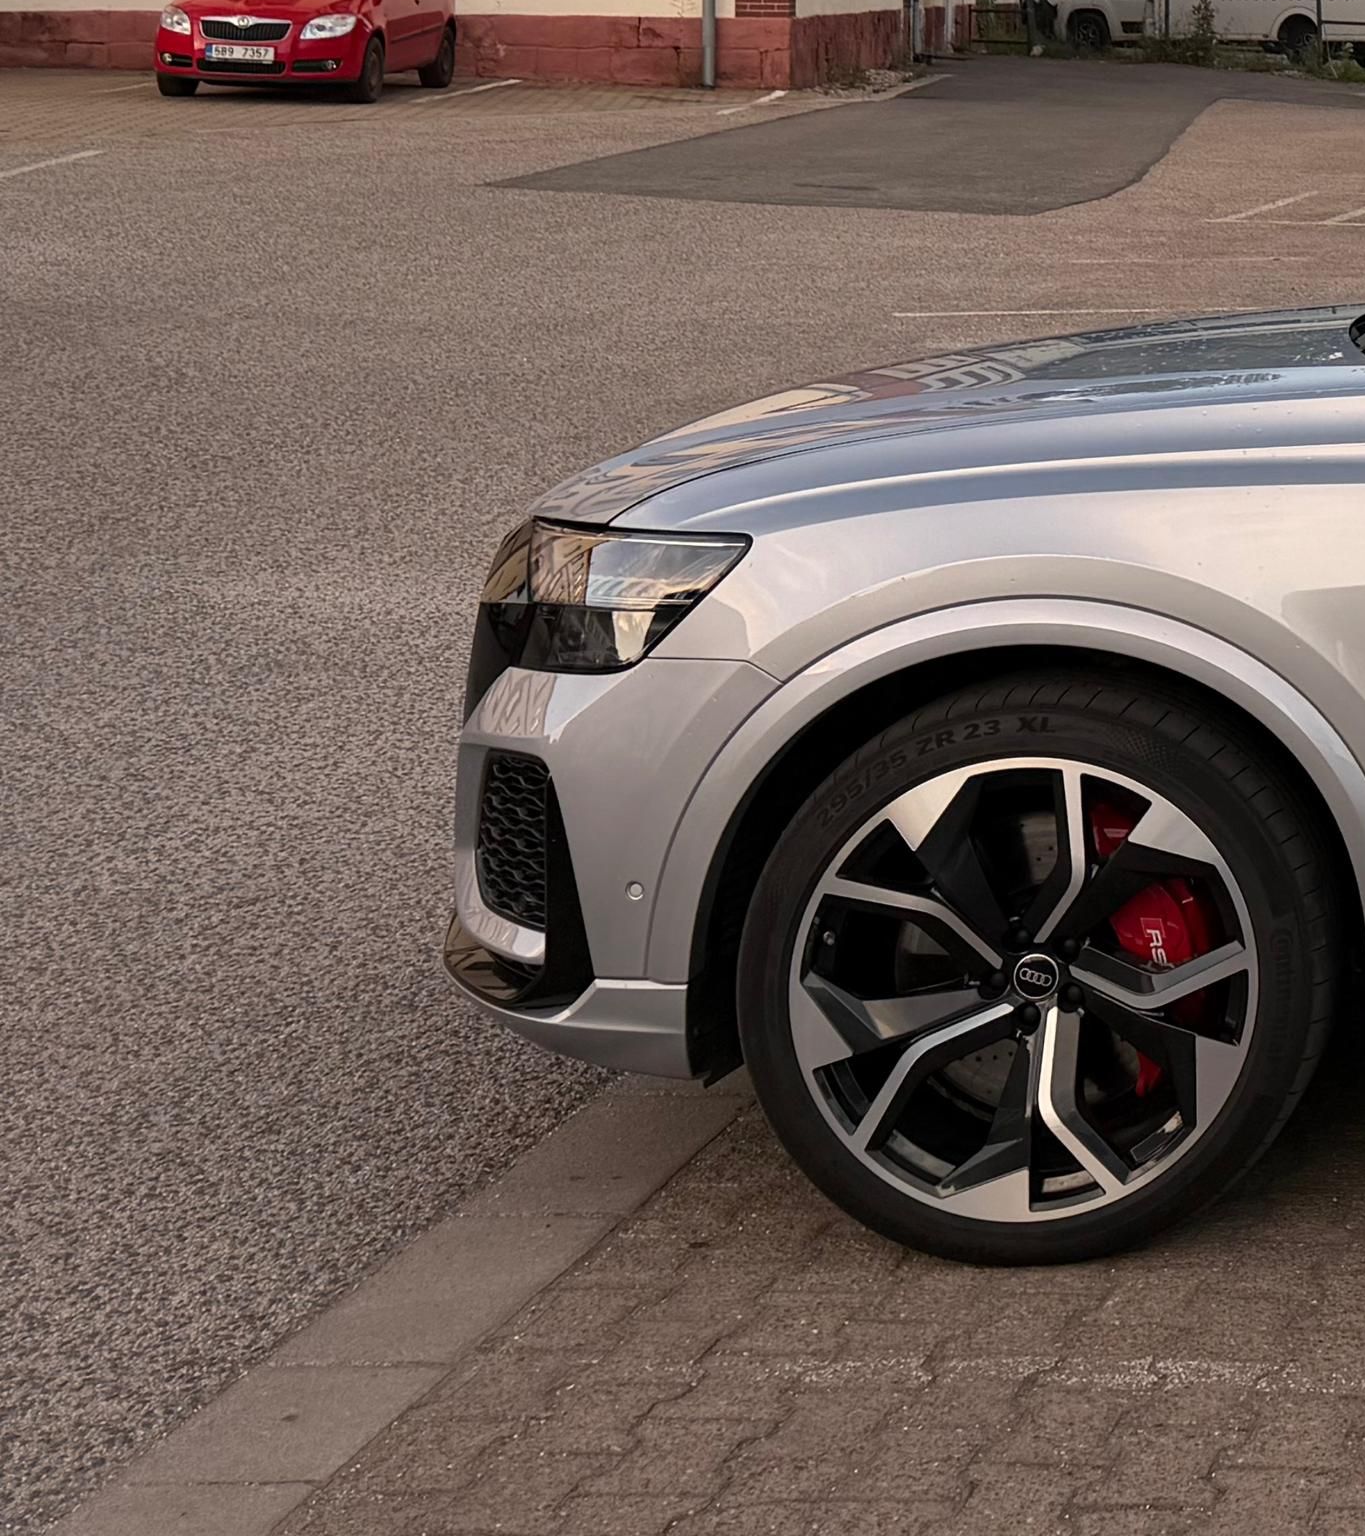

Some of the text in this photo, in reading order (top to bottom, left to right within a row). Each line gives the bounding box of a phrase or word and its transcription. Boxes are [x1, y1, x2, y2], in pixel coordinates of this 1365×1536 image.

[242, 47, 269, 58] 7357
[916, 730, 957, 757] ZR
[963, 719, 1000, 742] 23
[1015, 716, 1057, 735] XL
